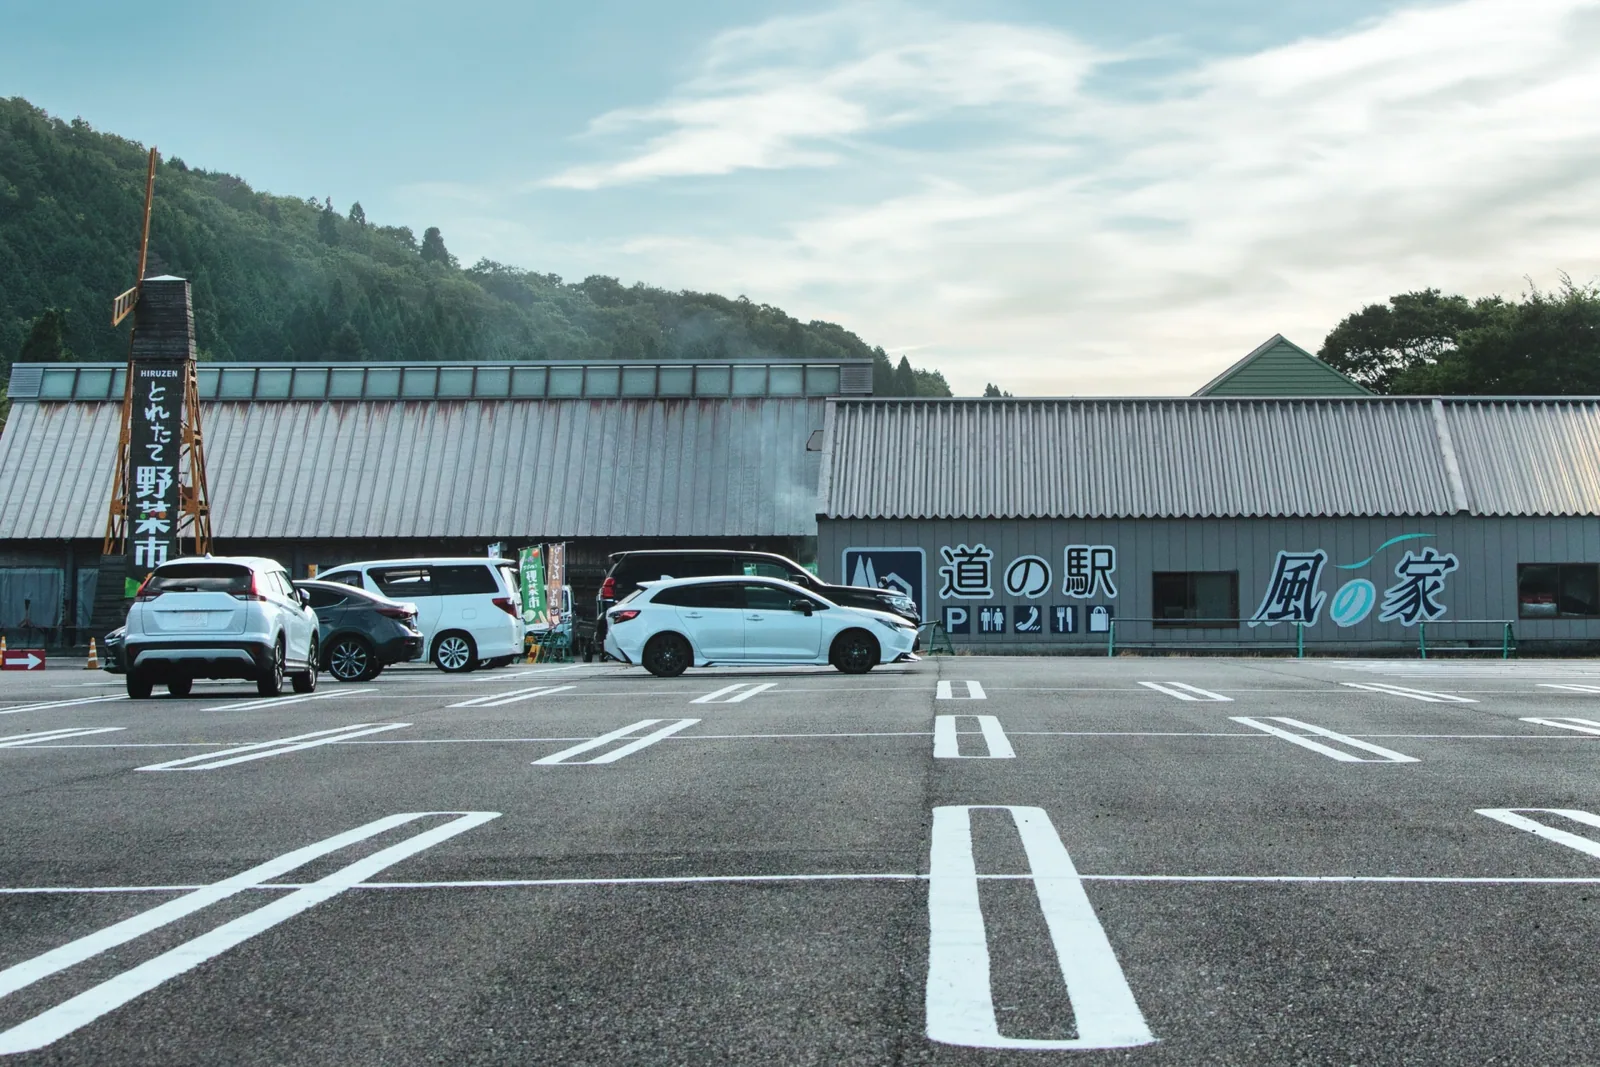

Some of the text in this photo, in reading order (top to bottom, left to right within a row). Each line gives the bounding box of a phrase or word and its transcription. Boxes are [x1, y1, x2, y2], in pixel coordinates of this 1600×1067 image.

[939, 543, 1117, 599] 道の駅
[1248, 547, 1460, 627] 風の家
[947, 608, 967, 632] P
